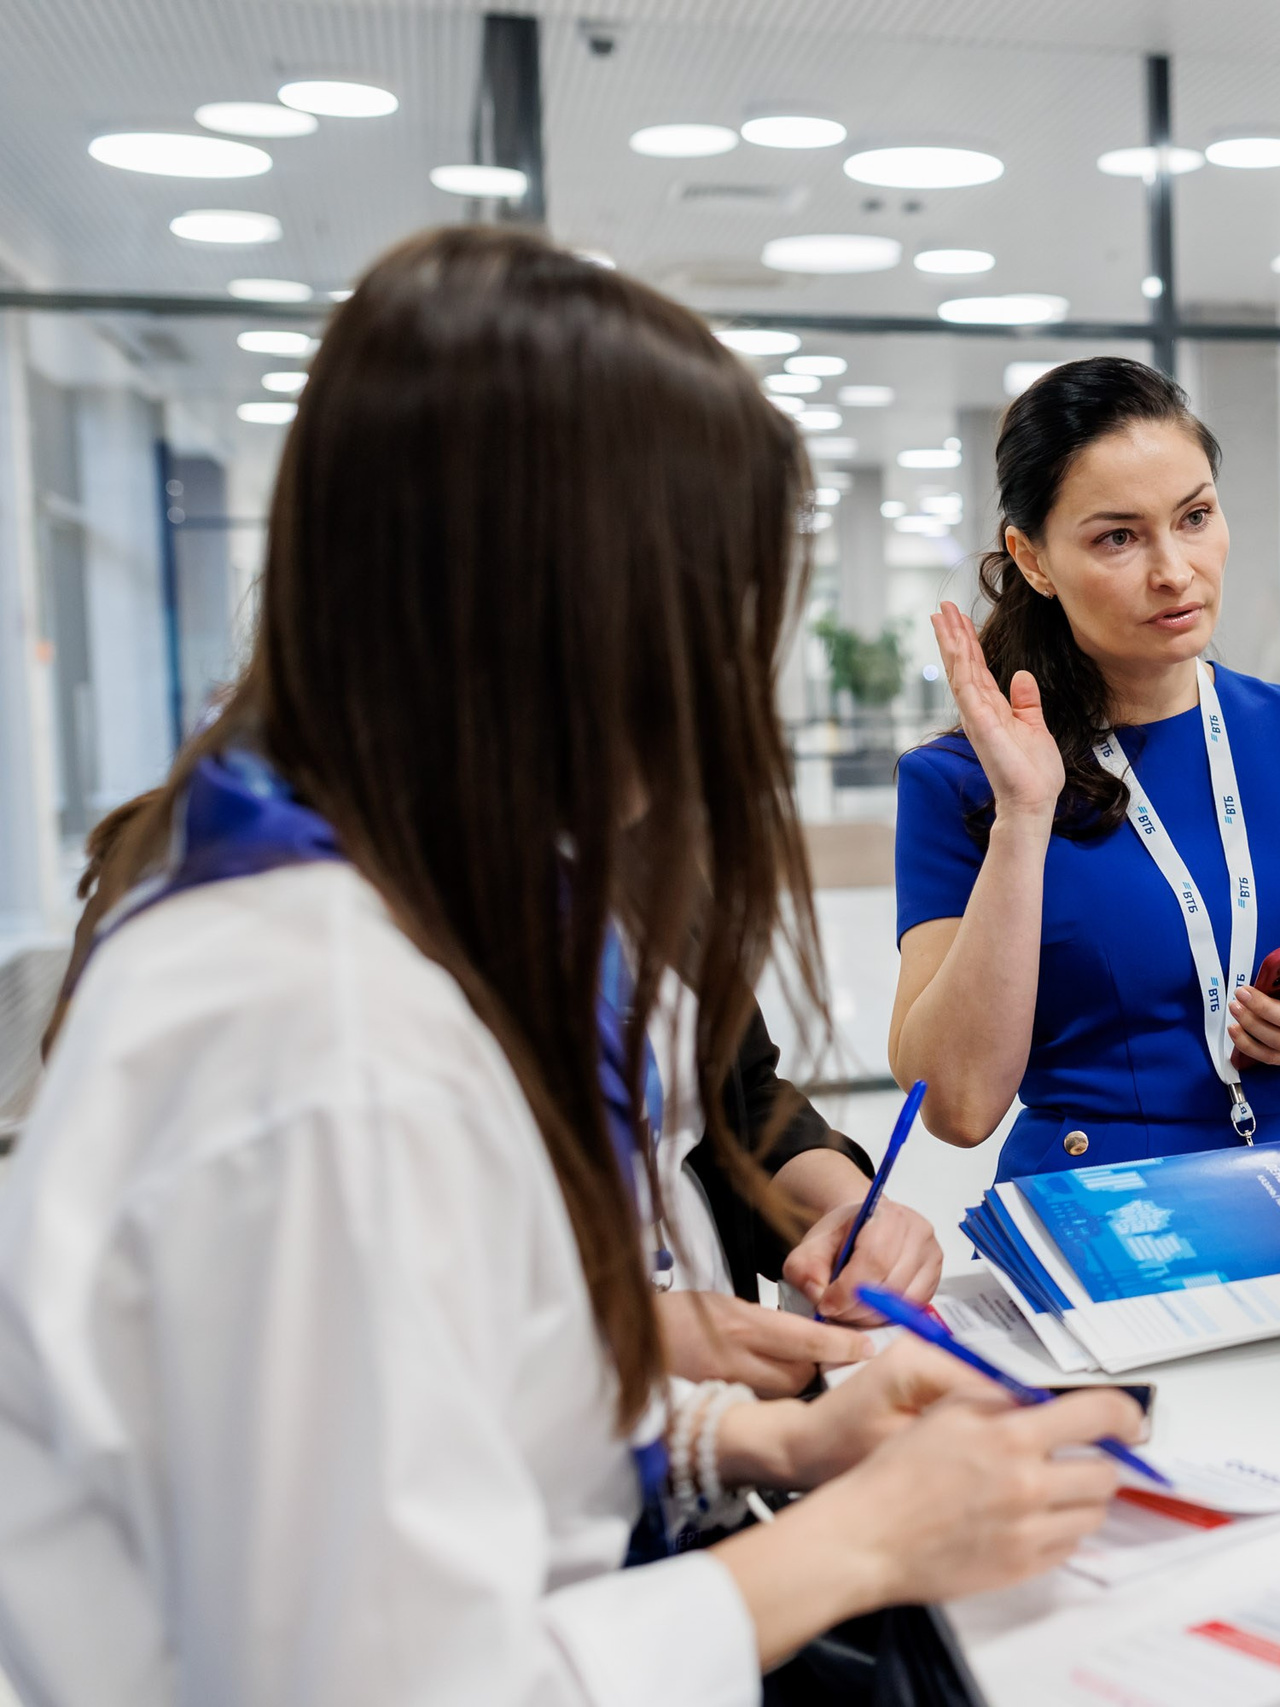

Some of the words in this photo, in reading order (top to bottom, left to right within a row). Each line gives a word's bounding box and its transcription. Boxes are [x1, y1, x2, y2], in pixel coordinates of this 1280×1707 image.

[1209, 715, 1221, 734] ВТБ
[1100, 741, 1114, 758] ТБ
[1223, 795, 1236, 815] ВТБ
[1138, 814, 1156, 835] ВТБ
[1239, 877, 1250, 898] ВТБ
[1183, 891, 1198, 913] ВТБ
[1208, 988, 1220, 1012] ВТБ
